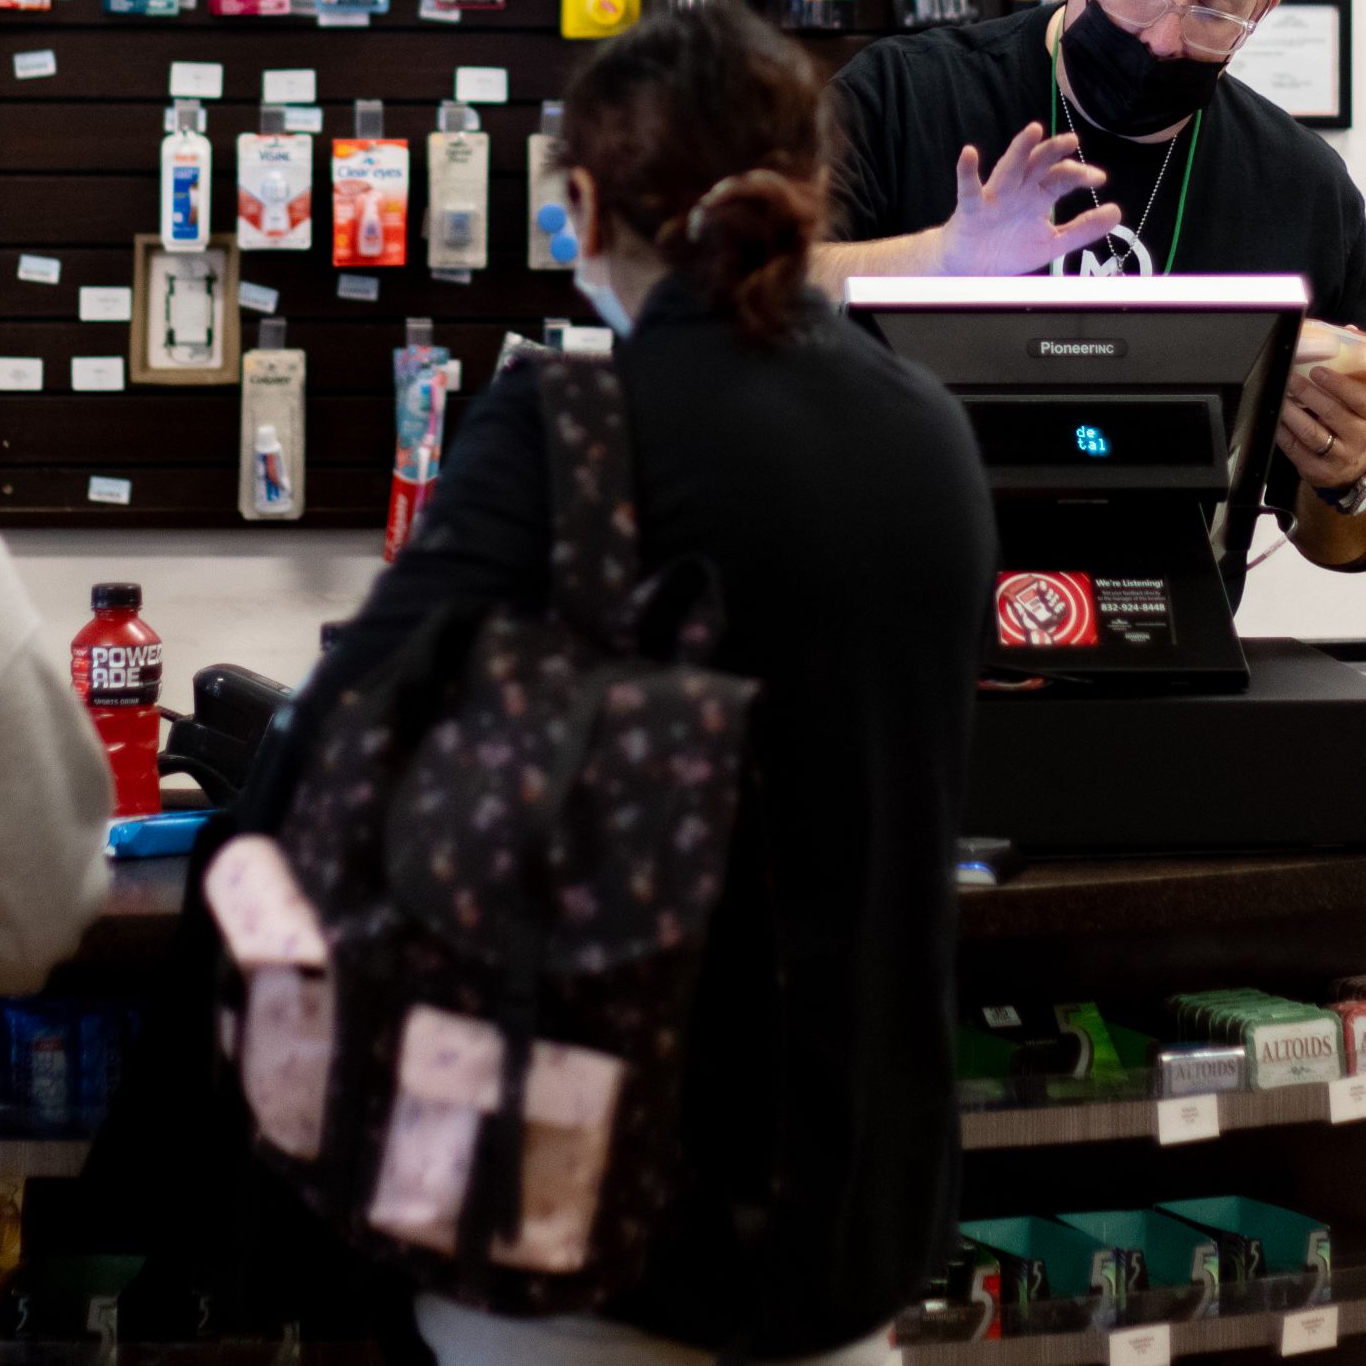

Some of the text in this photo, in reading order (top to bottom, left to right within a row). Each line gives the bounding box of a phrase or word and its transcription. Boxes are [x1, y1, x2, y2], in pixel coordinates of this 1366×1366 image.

[337, 166, 402, 181] Clear eyes
[1076, 426, 1095, 438] de
[1077, 438, 1106, 452] tal
[1096, 579, 1163, 589] We're Listening!
[1262, 1034, 1333, 1064] ALTOIDS
